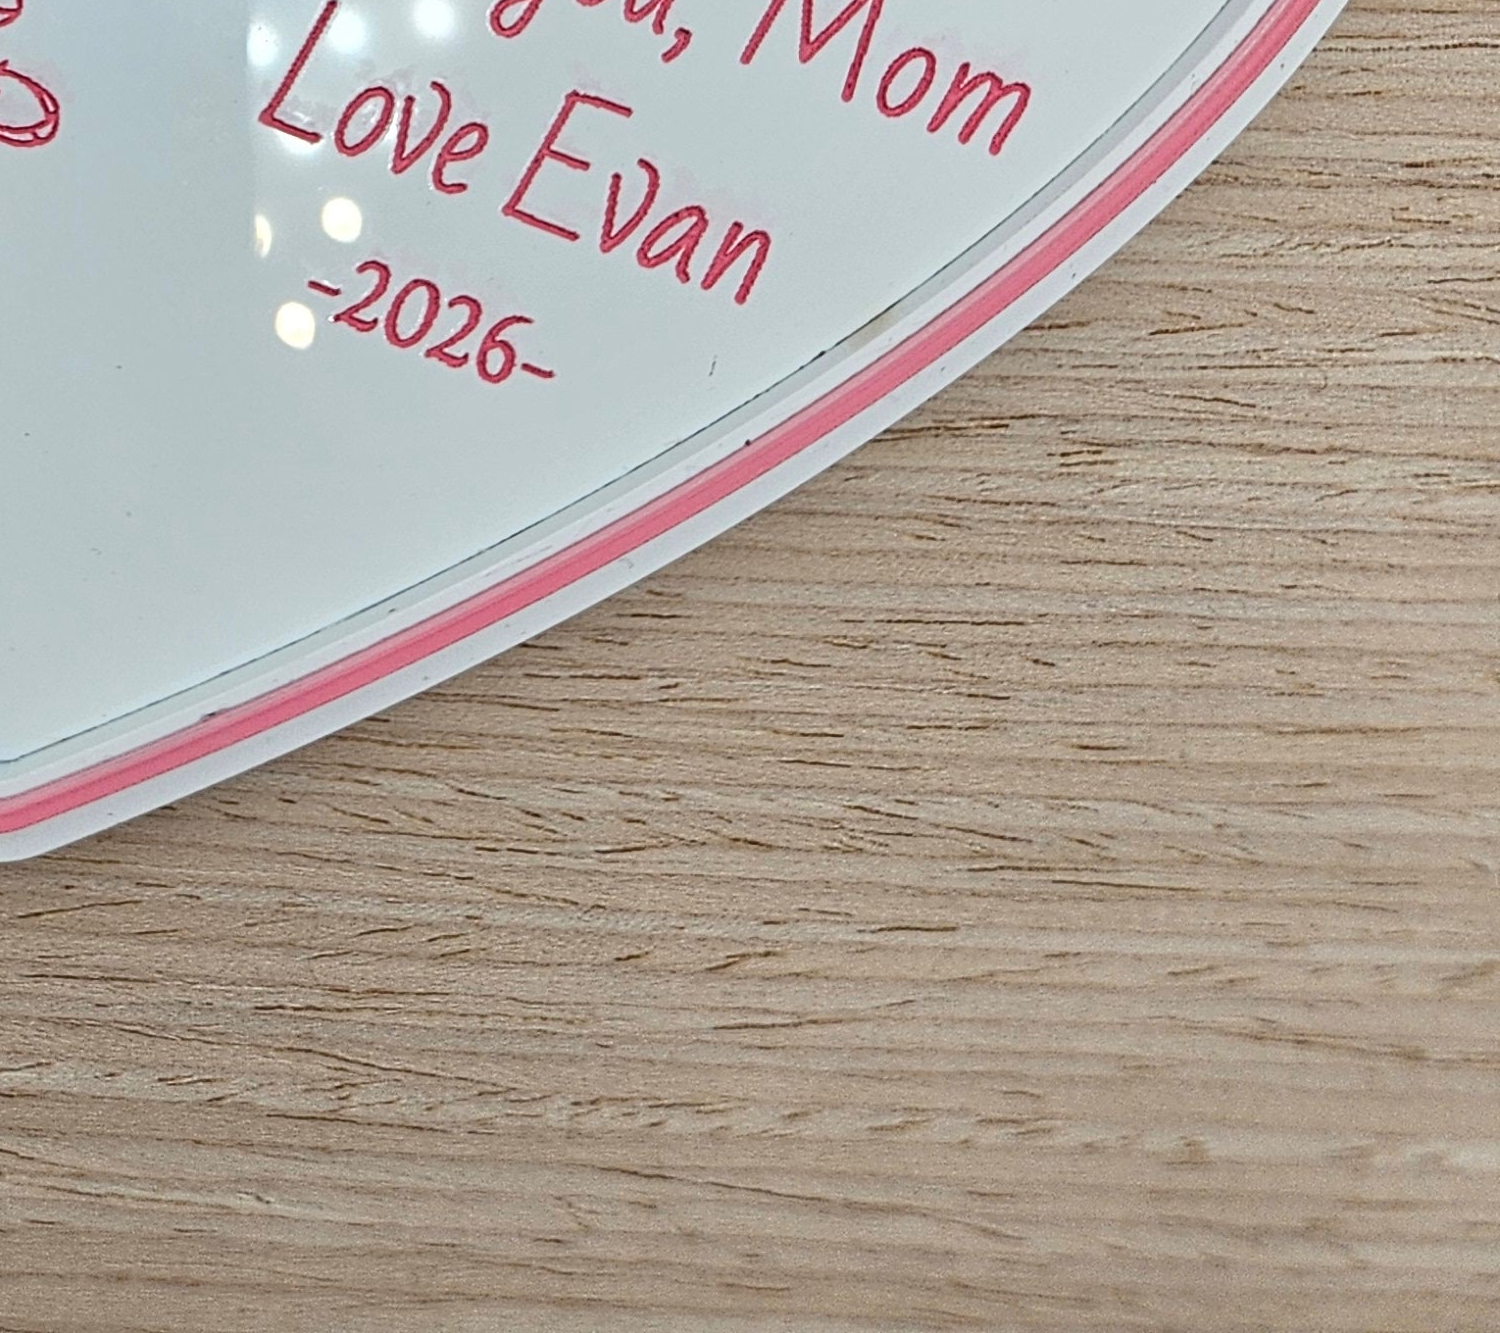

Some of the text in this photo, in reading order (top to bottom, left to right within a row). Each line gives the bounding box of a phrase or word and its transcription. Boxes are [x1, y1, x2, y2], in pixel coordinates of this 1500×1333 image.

[259, 0, 772, 305] Love Evan
[308, 260, 556, 384] -2026-
